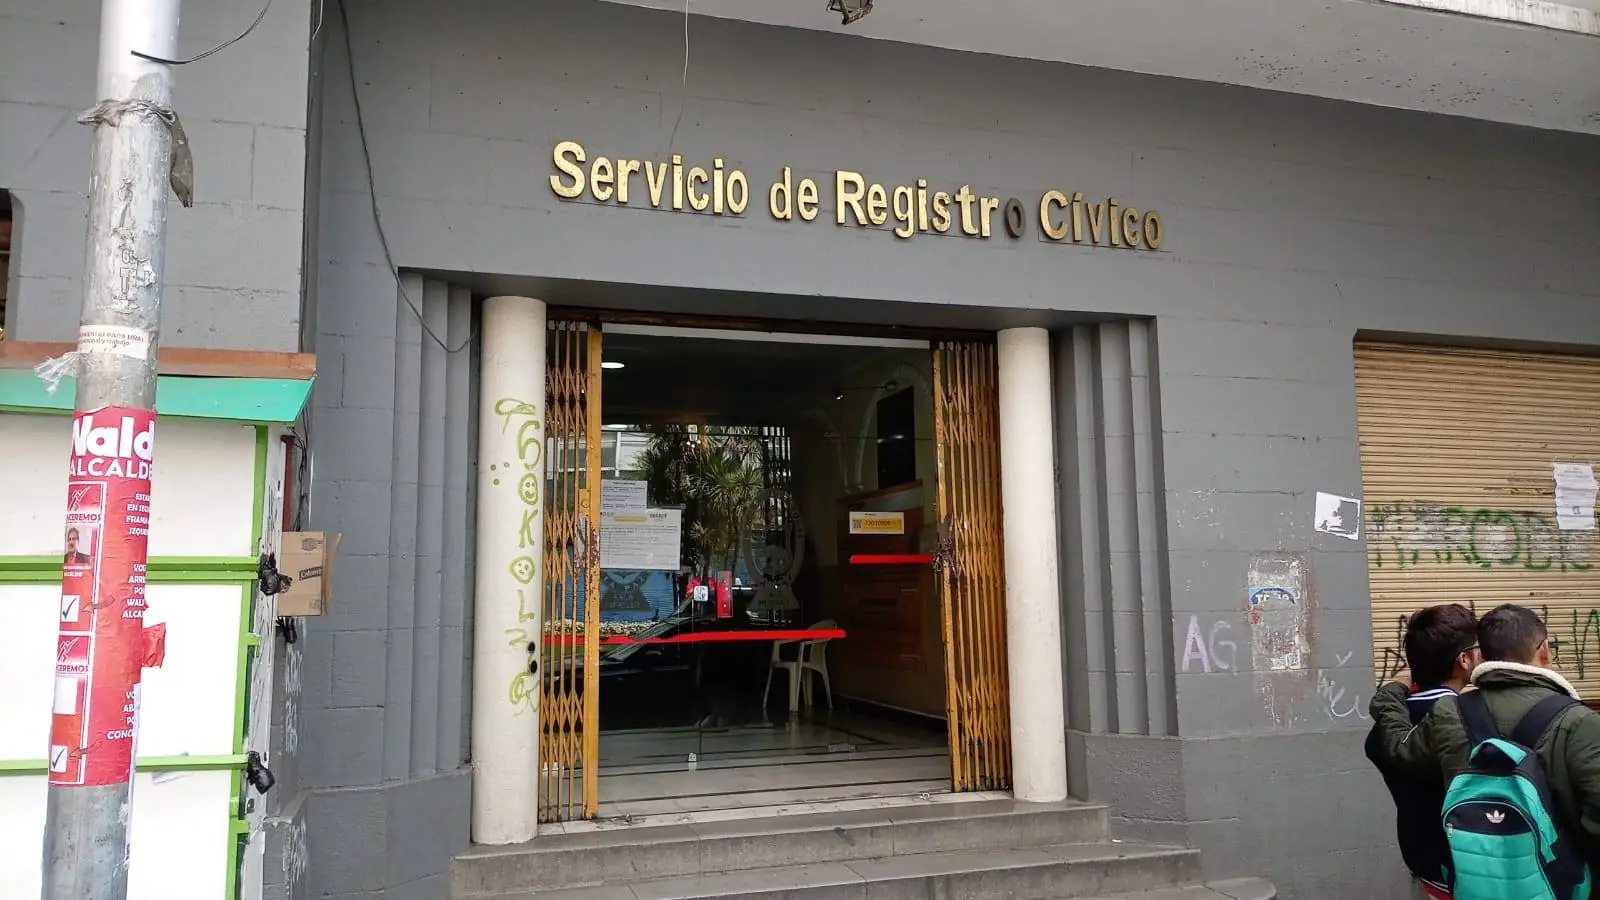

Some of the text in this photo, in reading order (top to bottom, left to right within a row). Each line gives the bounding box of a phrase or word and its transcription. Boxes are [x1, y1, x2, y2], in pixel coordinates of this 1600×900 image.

[549, 140, 1163, 250] Servicio de Registro Cívico
